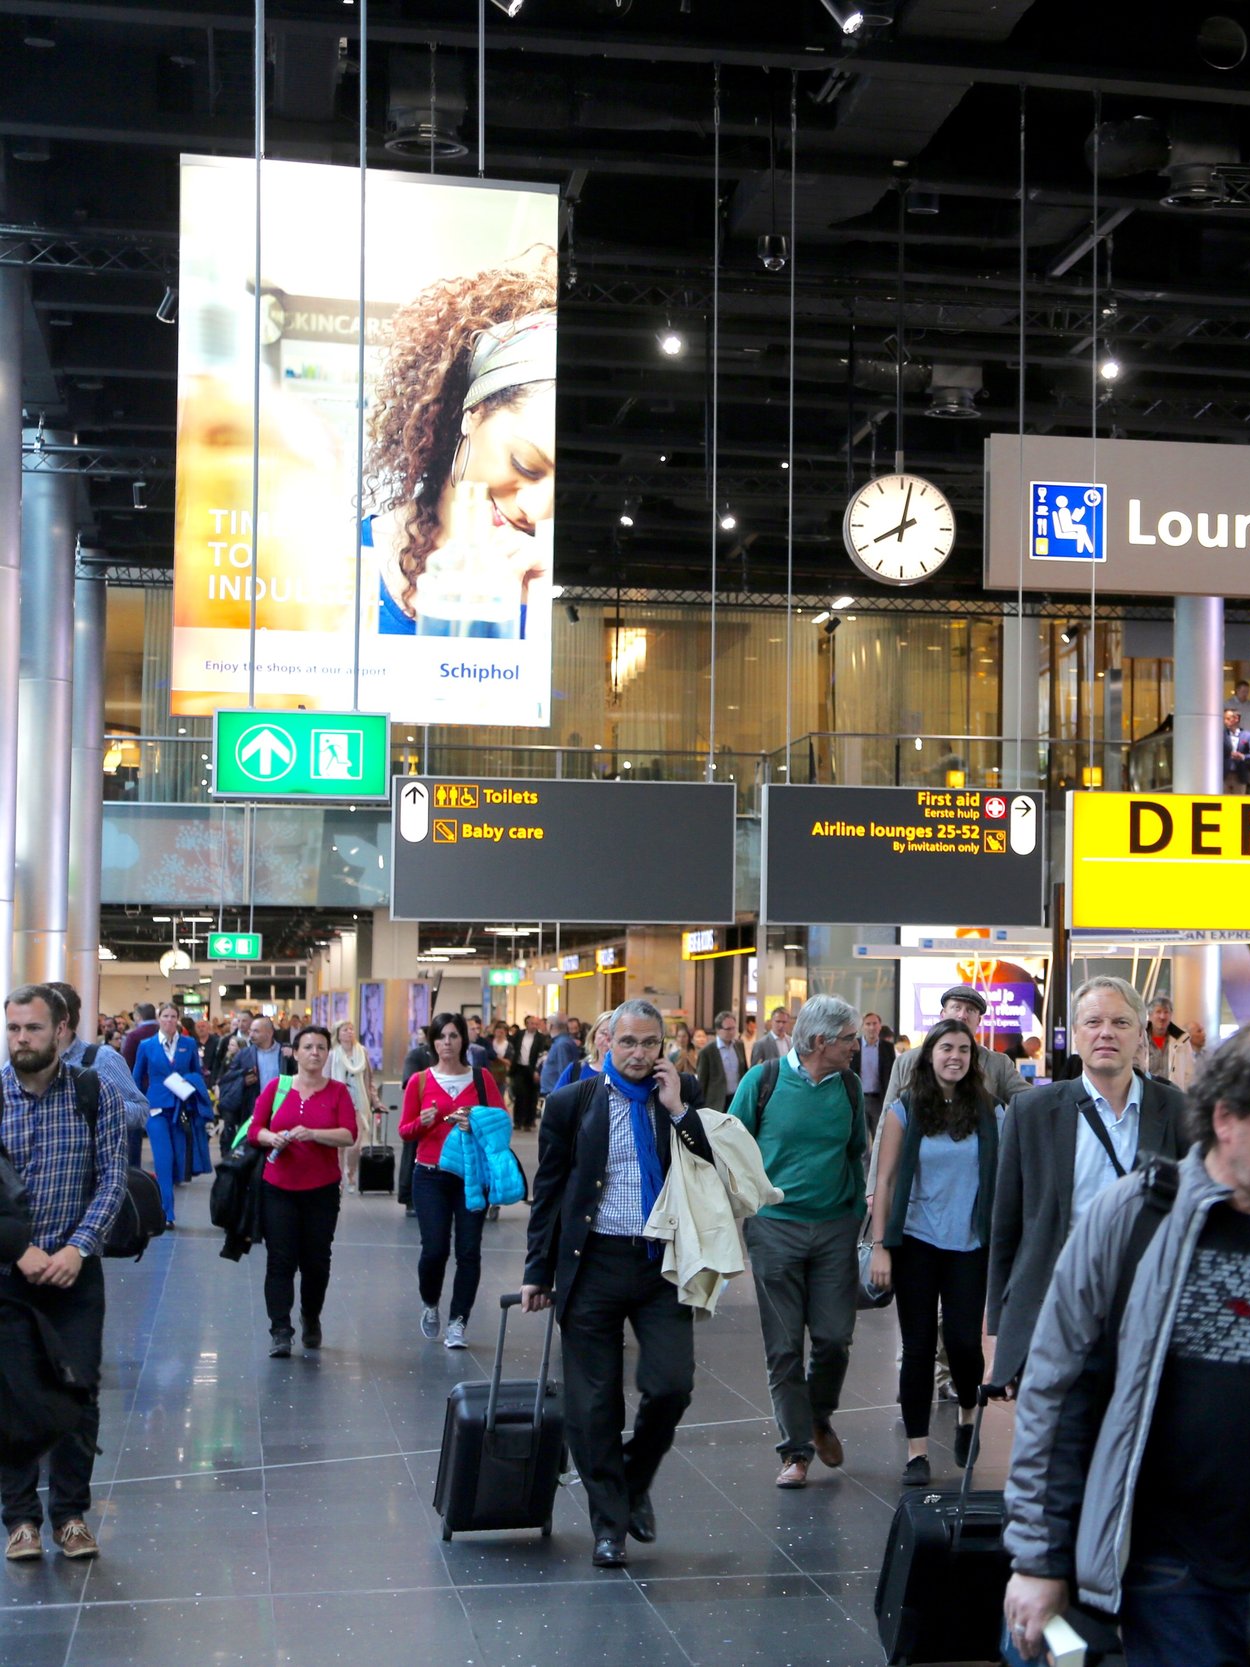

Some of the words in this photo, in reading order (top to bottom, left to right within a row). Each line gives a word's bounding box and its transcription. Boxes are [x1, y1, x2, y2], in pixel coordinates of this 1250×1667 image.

[207, 541, 254, 568] TO
[205, 660, 239, 673] Enjoy
[243, 662, 263, 672] te
[267, 663, 302, 675] shops
[305, 666, 317, 674] at
[345, 666, 387, 677] aport
[439, 662, 520, 683] Schiphol
[483, 788, 539, 805] Toilets
[917, 791, 952, 807] First
[956, 792, 980, 807] aid
[924, 808, 955, 819] Eerste
[957, 808, 980, 820] hulp
[462, 823, 505, 843] Baby
[508, 826, 544, 840] care
[811, 821, 866, 838] Airline
[870, 823, 933, 841] lounges
[937, 825, 980, 840] 25-52
[892, 841, 902, 853] By
[907, 841, 955, 853] invitation
[958, 842, 980, 854] only
